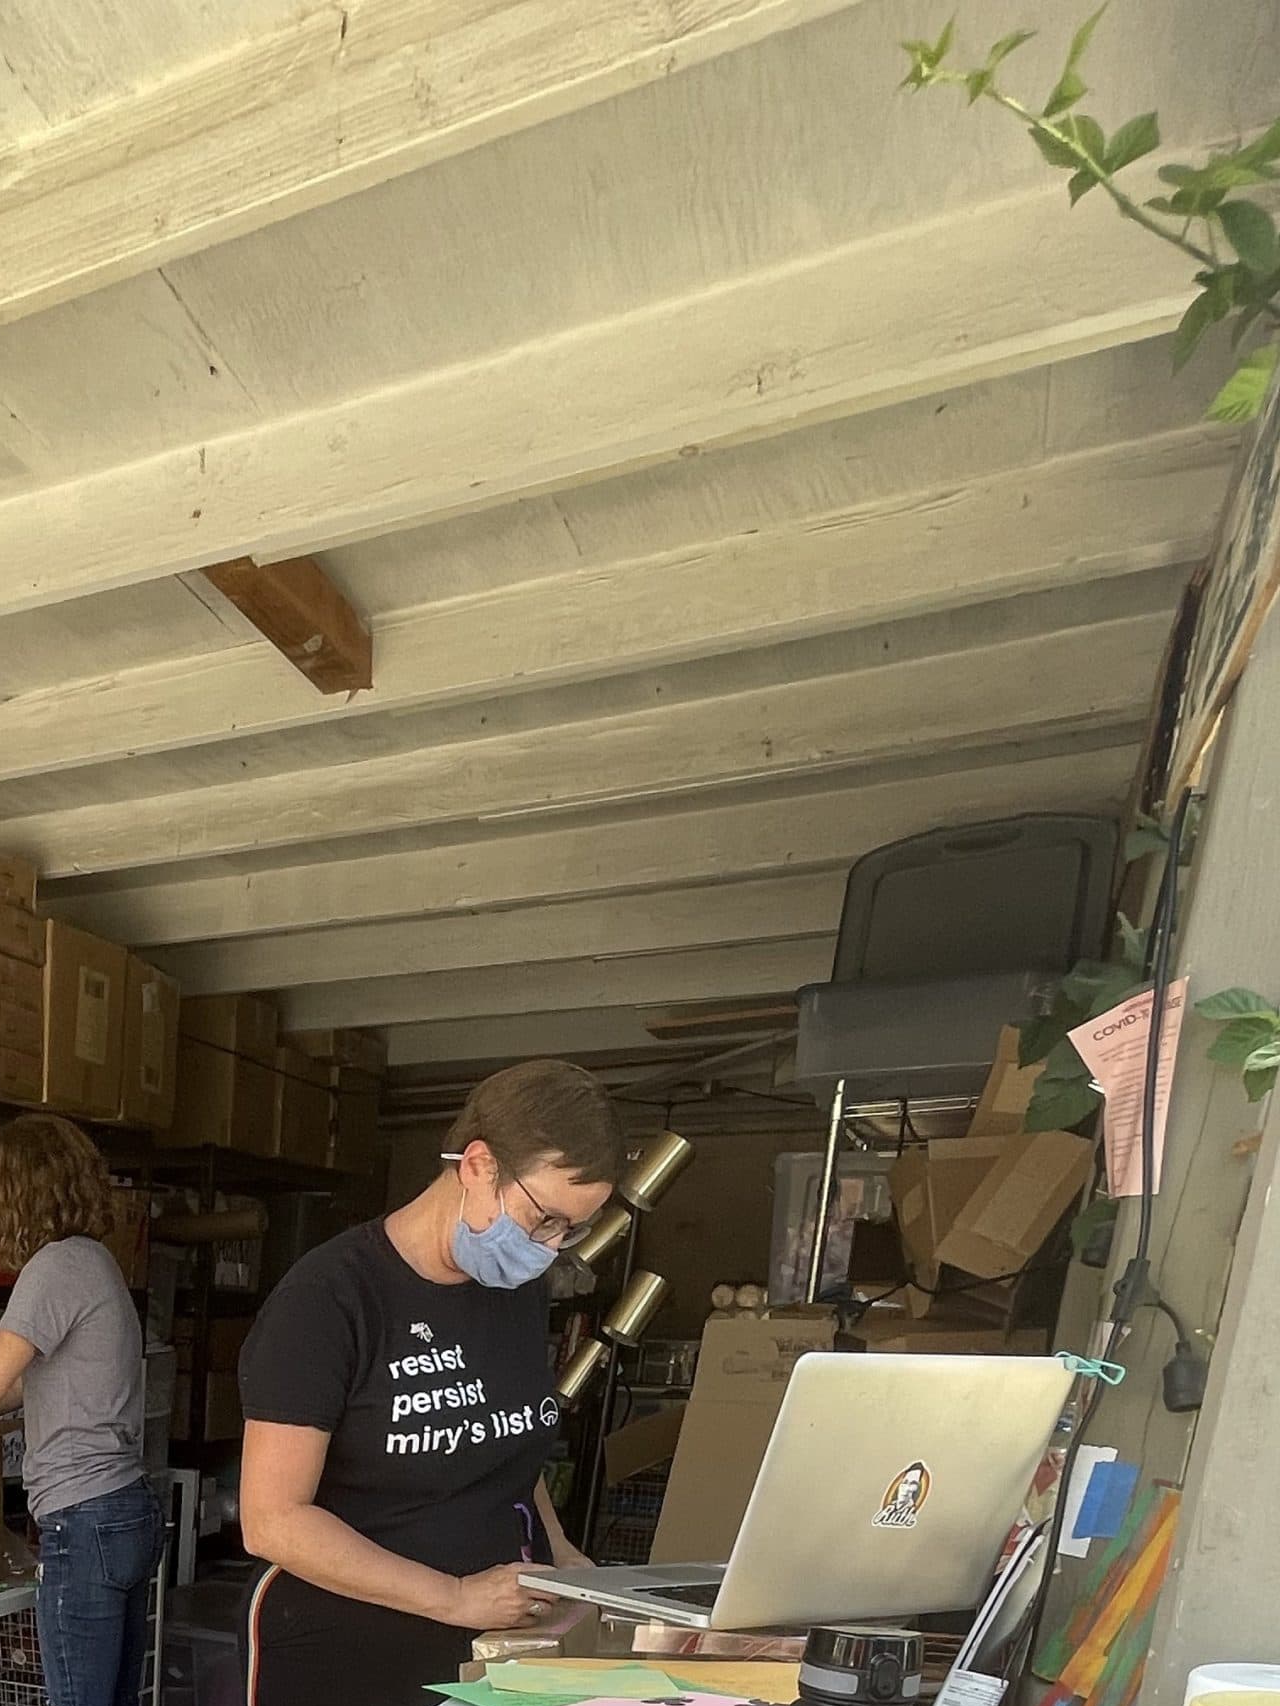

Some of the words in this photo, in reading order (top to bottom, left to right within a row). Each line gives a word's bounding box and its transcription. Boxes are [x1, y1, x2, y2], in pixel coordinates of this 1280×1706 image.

[388, 1344, 465, 1379] resist
[392, 1378, 486, 1422] persist
[385, 1419, 486, 1455] miry's
[491, 1405, 534, 1438] list
